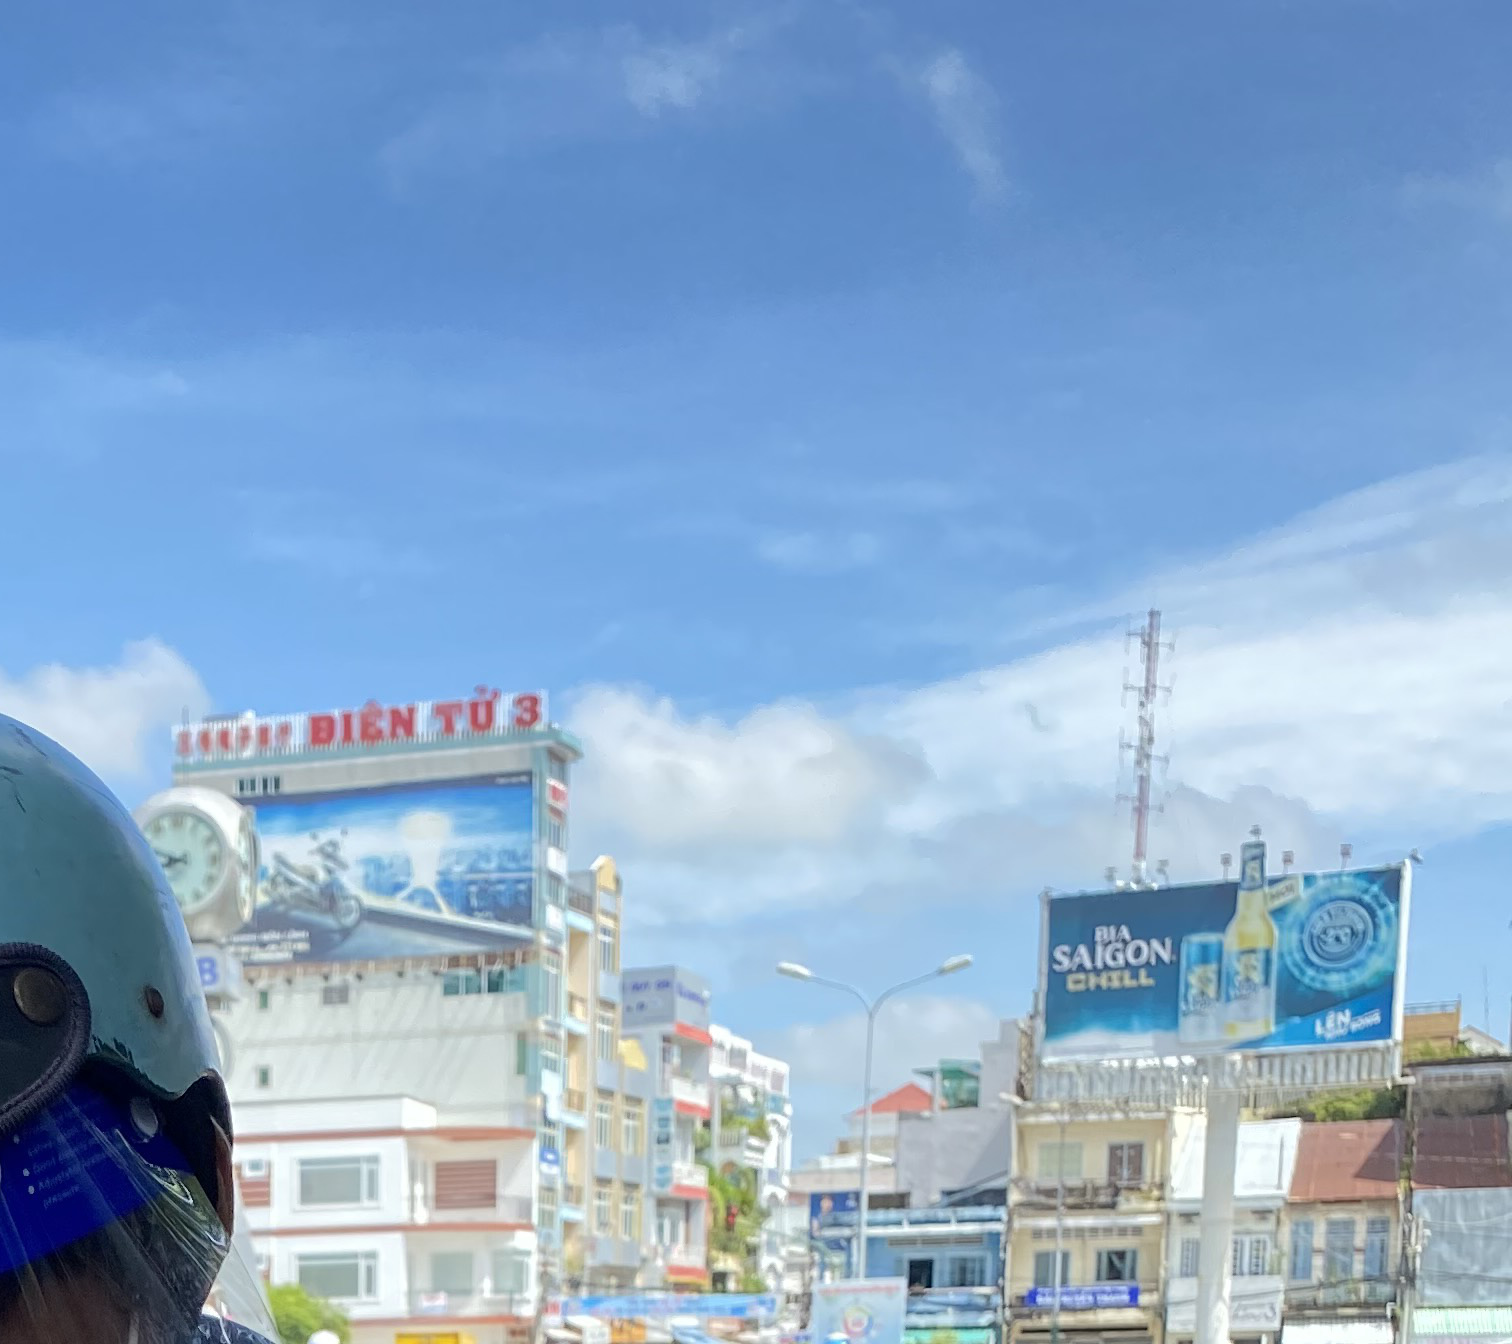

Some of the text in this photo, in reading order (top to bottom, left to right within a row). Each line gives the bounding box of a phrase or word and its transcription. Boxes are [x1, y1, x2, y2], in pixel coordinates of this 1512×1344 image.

[514, 693, 542, 728] 3
[1094, 925, 1131, 944] BIA
[1052, 936, 1175, 973] SAIGON
[1066, 968, 1155, 992] CHILL
